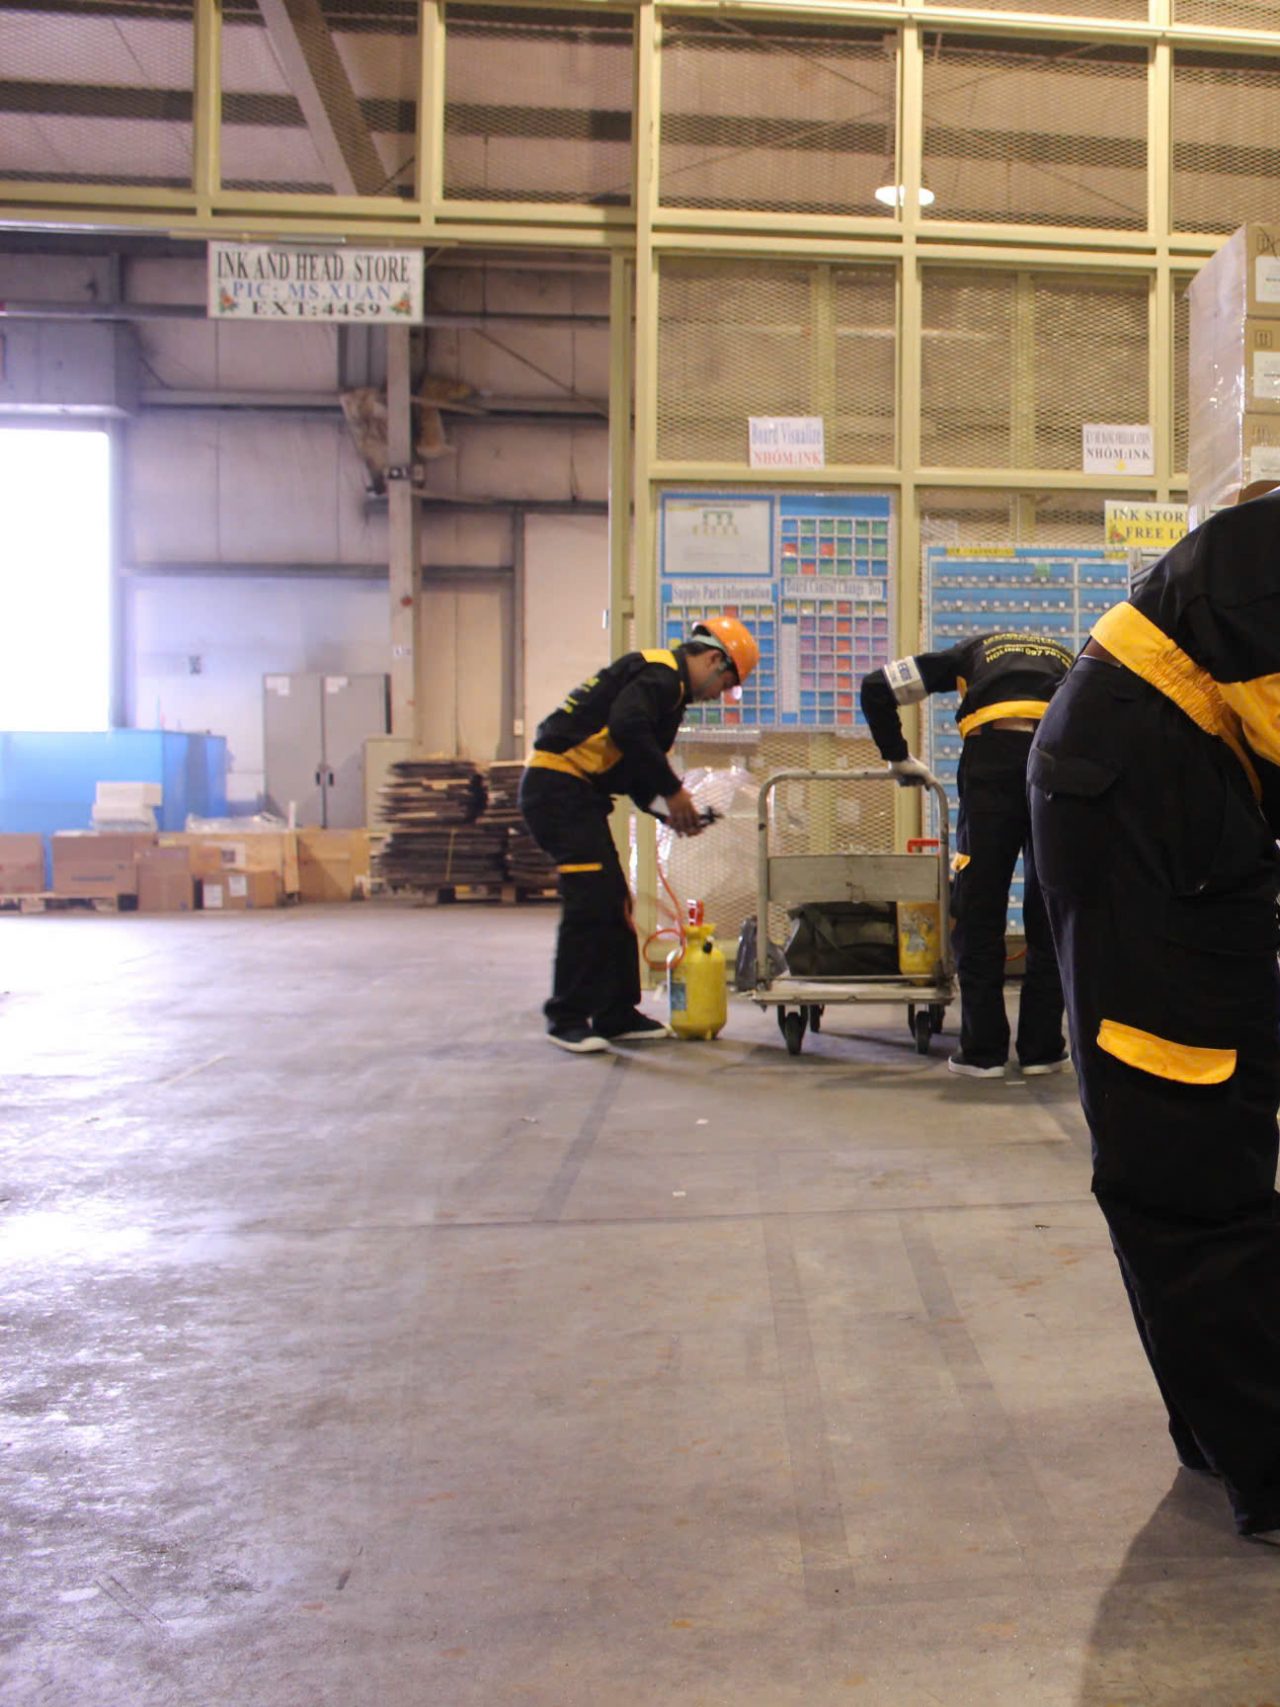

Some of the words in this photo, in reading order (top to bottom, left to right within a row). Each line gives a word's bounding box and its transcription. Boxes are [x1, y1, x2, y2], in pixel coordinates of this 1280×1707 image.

[217, 251, 249, 279] INK
[254, 251, 290, 281] AND
[296, 252, 344, 282] HEAD
[353, 254, 410, 283] STORE
[232, 282, 279, 299] PIC:
[252, 301, 382, 316] EXT:4459
[1113, 508, 1138, 521] INK
[1144, 510, 1188, 523] STOR
[1125, 526, 1164, 540] FREE
